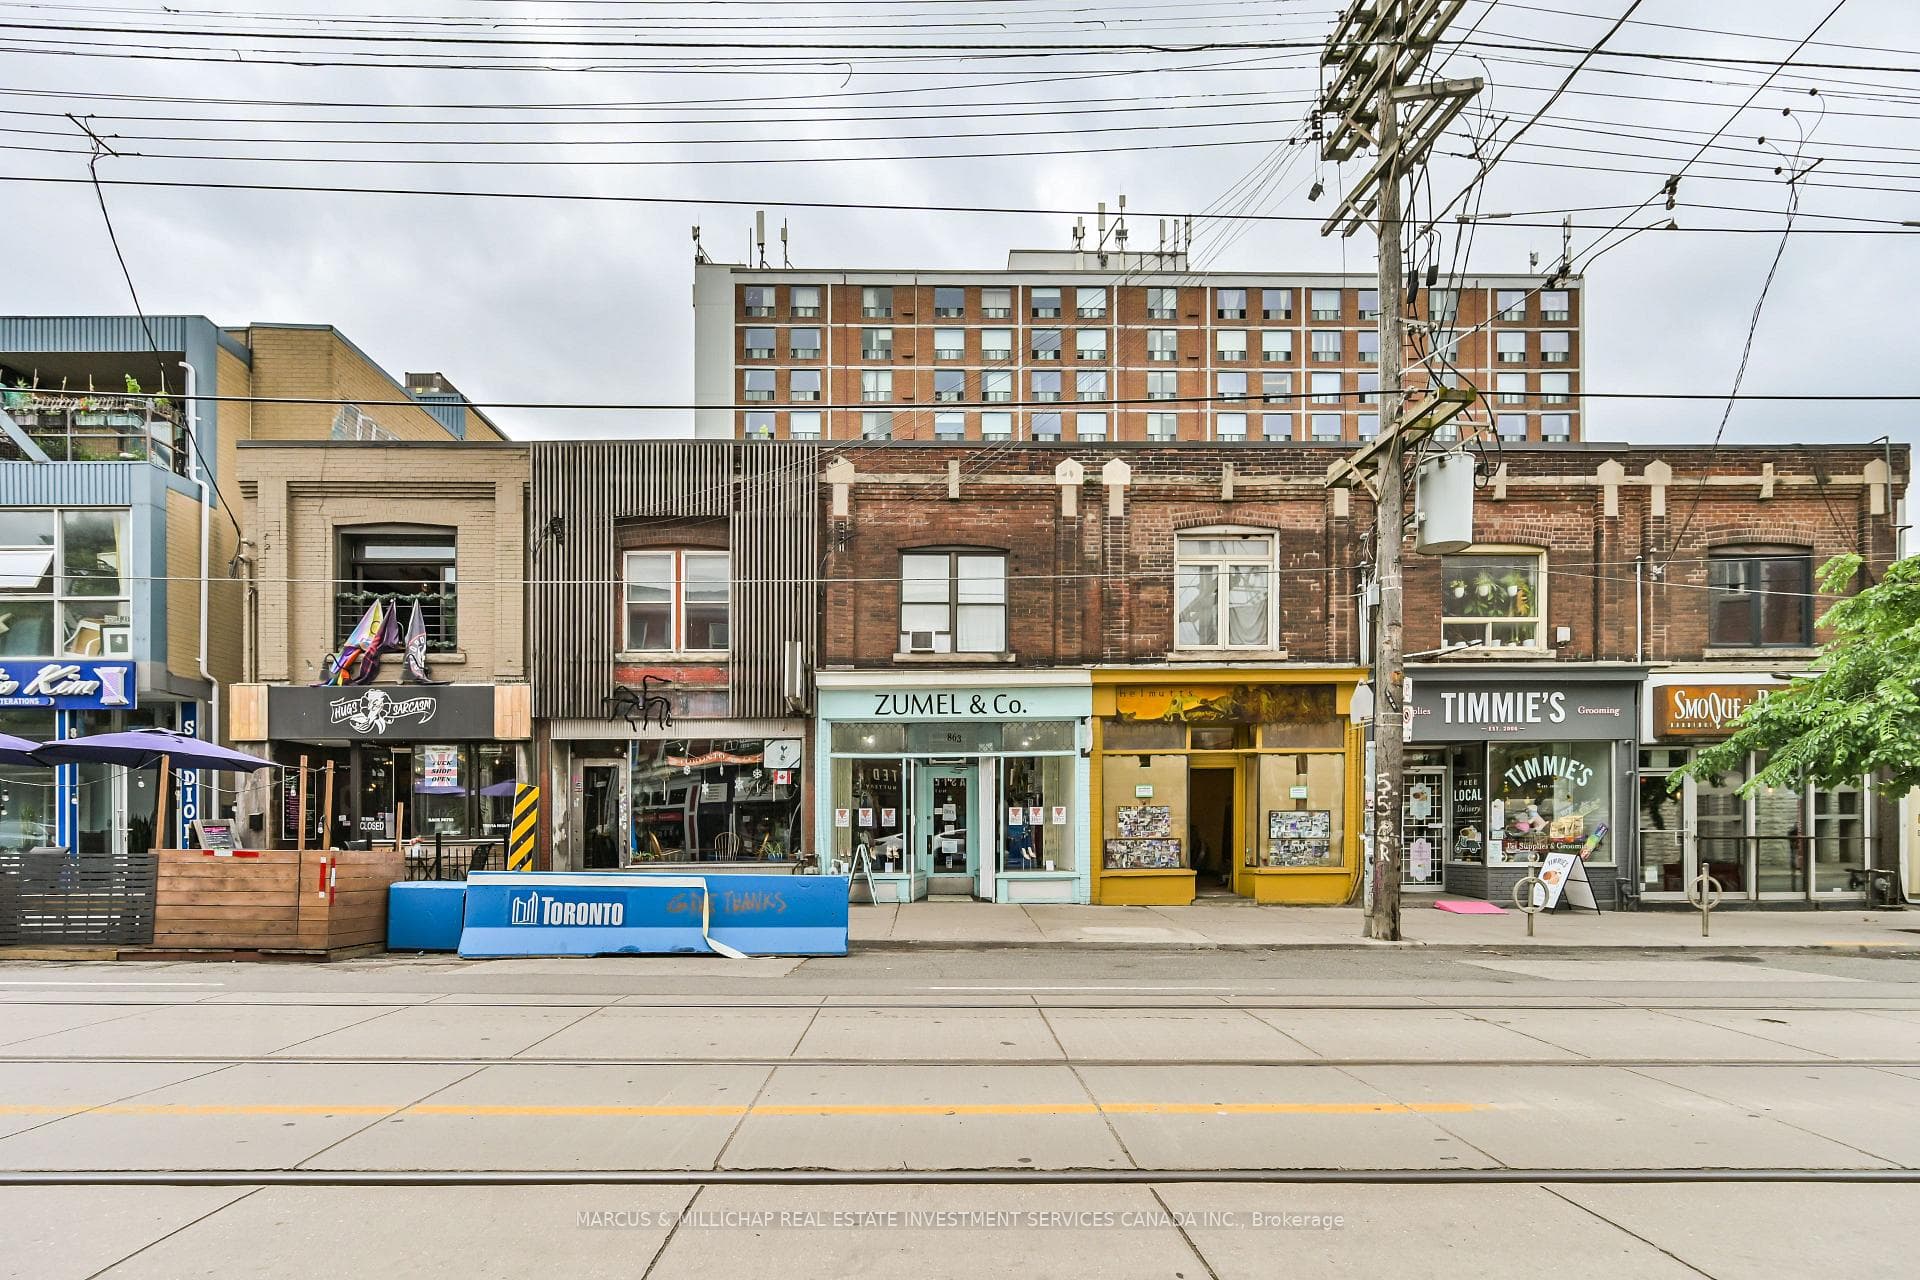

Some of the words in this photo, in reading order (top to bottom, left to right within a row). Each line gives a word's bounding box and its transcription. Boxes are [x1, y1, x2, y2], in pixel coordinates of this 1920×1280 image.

[22, 664, 100, 696] Kim
[334, 702, 358, 720] HUGS
[393, 699, 432, 716] SARCASM
[874, 694, 962, 715] ZUMEL
[969, 694, 988, 715] &
[993, 694, 1027, 715] Co.
[1441, 692, 1567, 725] TIMMIE'S
[1577, 705, 1620, 717] Grooming
[1504, 755, 1594, 787] TIMMIE'S
[1454, 788, 1483, 801] LOCAL
[360, 821, 384, 831] CLOSED
[1519, 842, 1549, 851] Supplies
[541, 896, 624, 926] TORONTO
